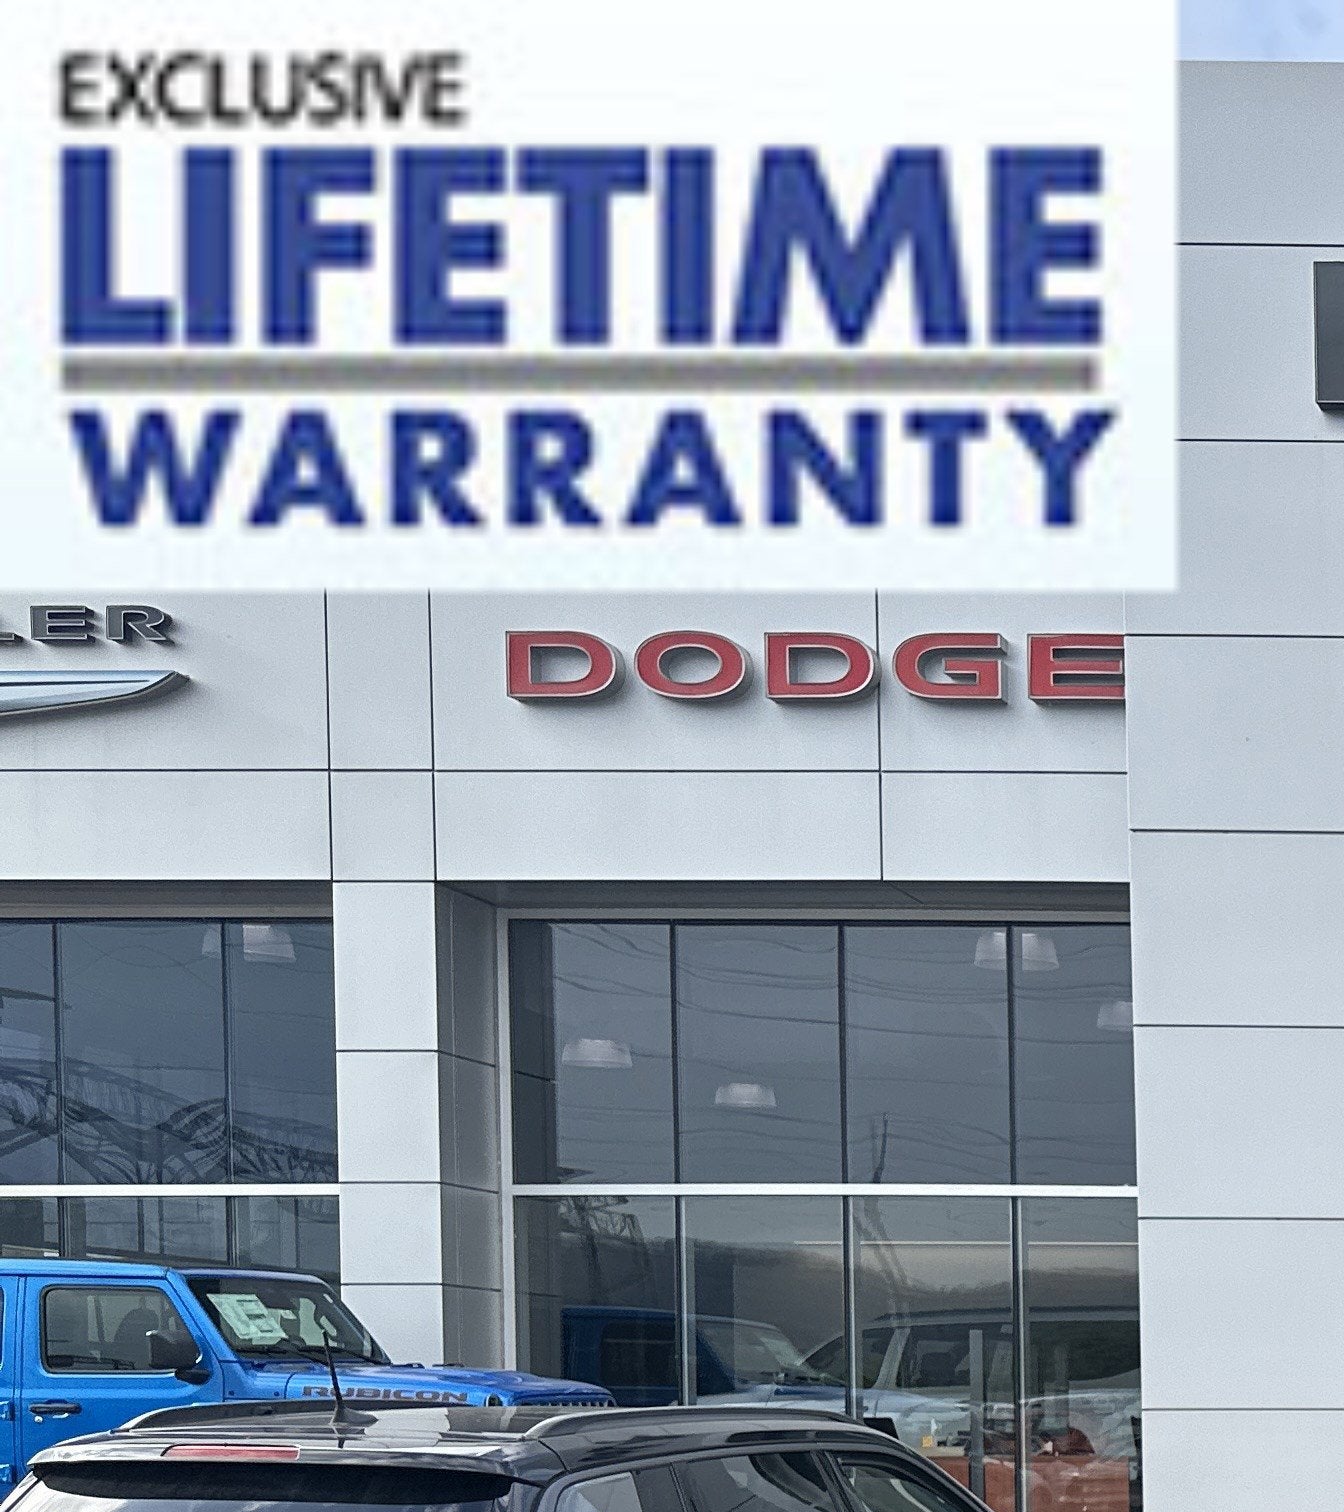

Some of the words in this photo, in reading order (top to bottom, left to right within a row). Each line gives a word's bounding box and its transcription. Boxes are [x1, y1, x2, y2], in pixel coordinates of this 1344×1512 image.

[0, 604, 170, 643] ER
[505, 630, 1125, 702] DODGE
[303, 1385, 468, 1402] RUBICON
